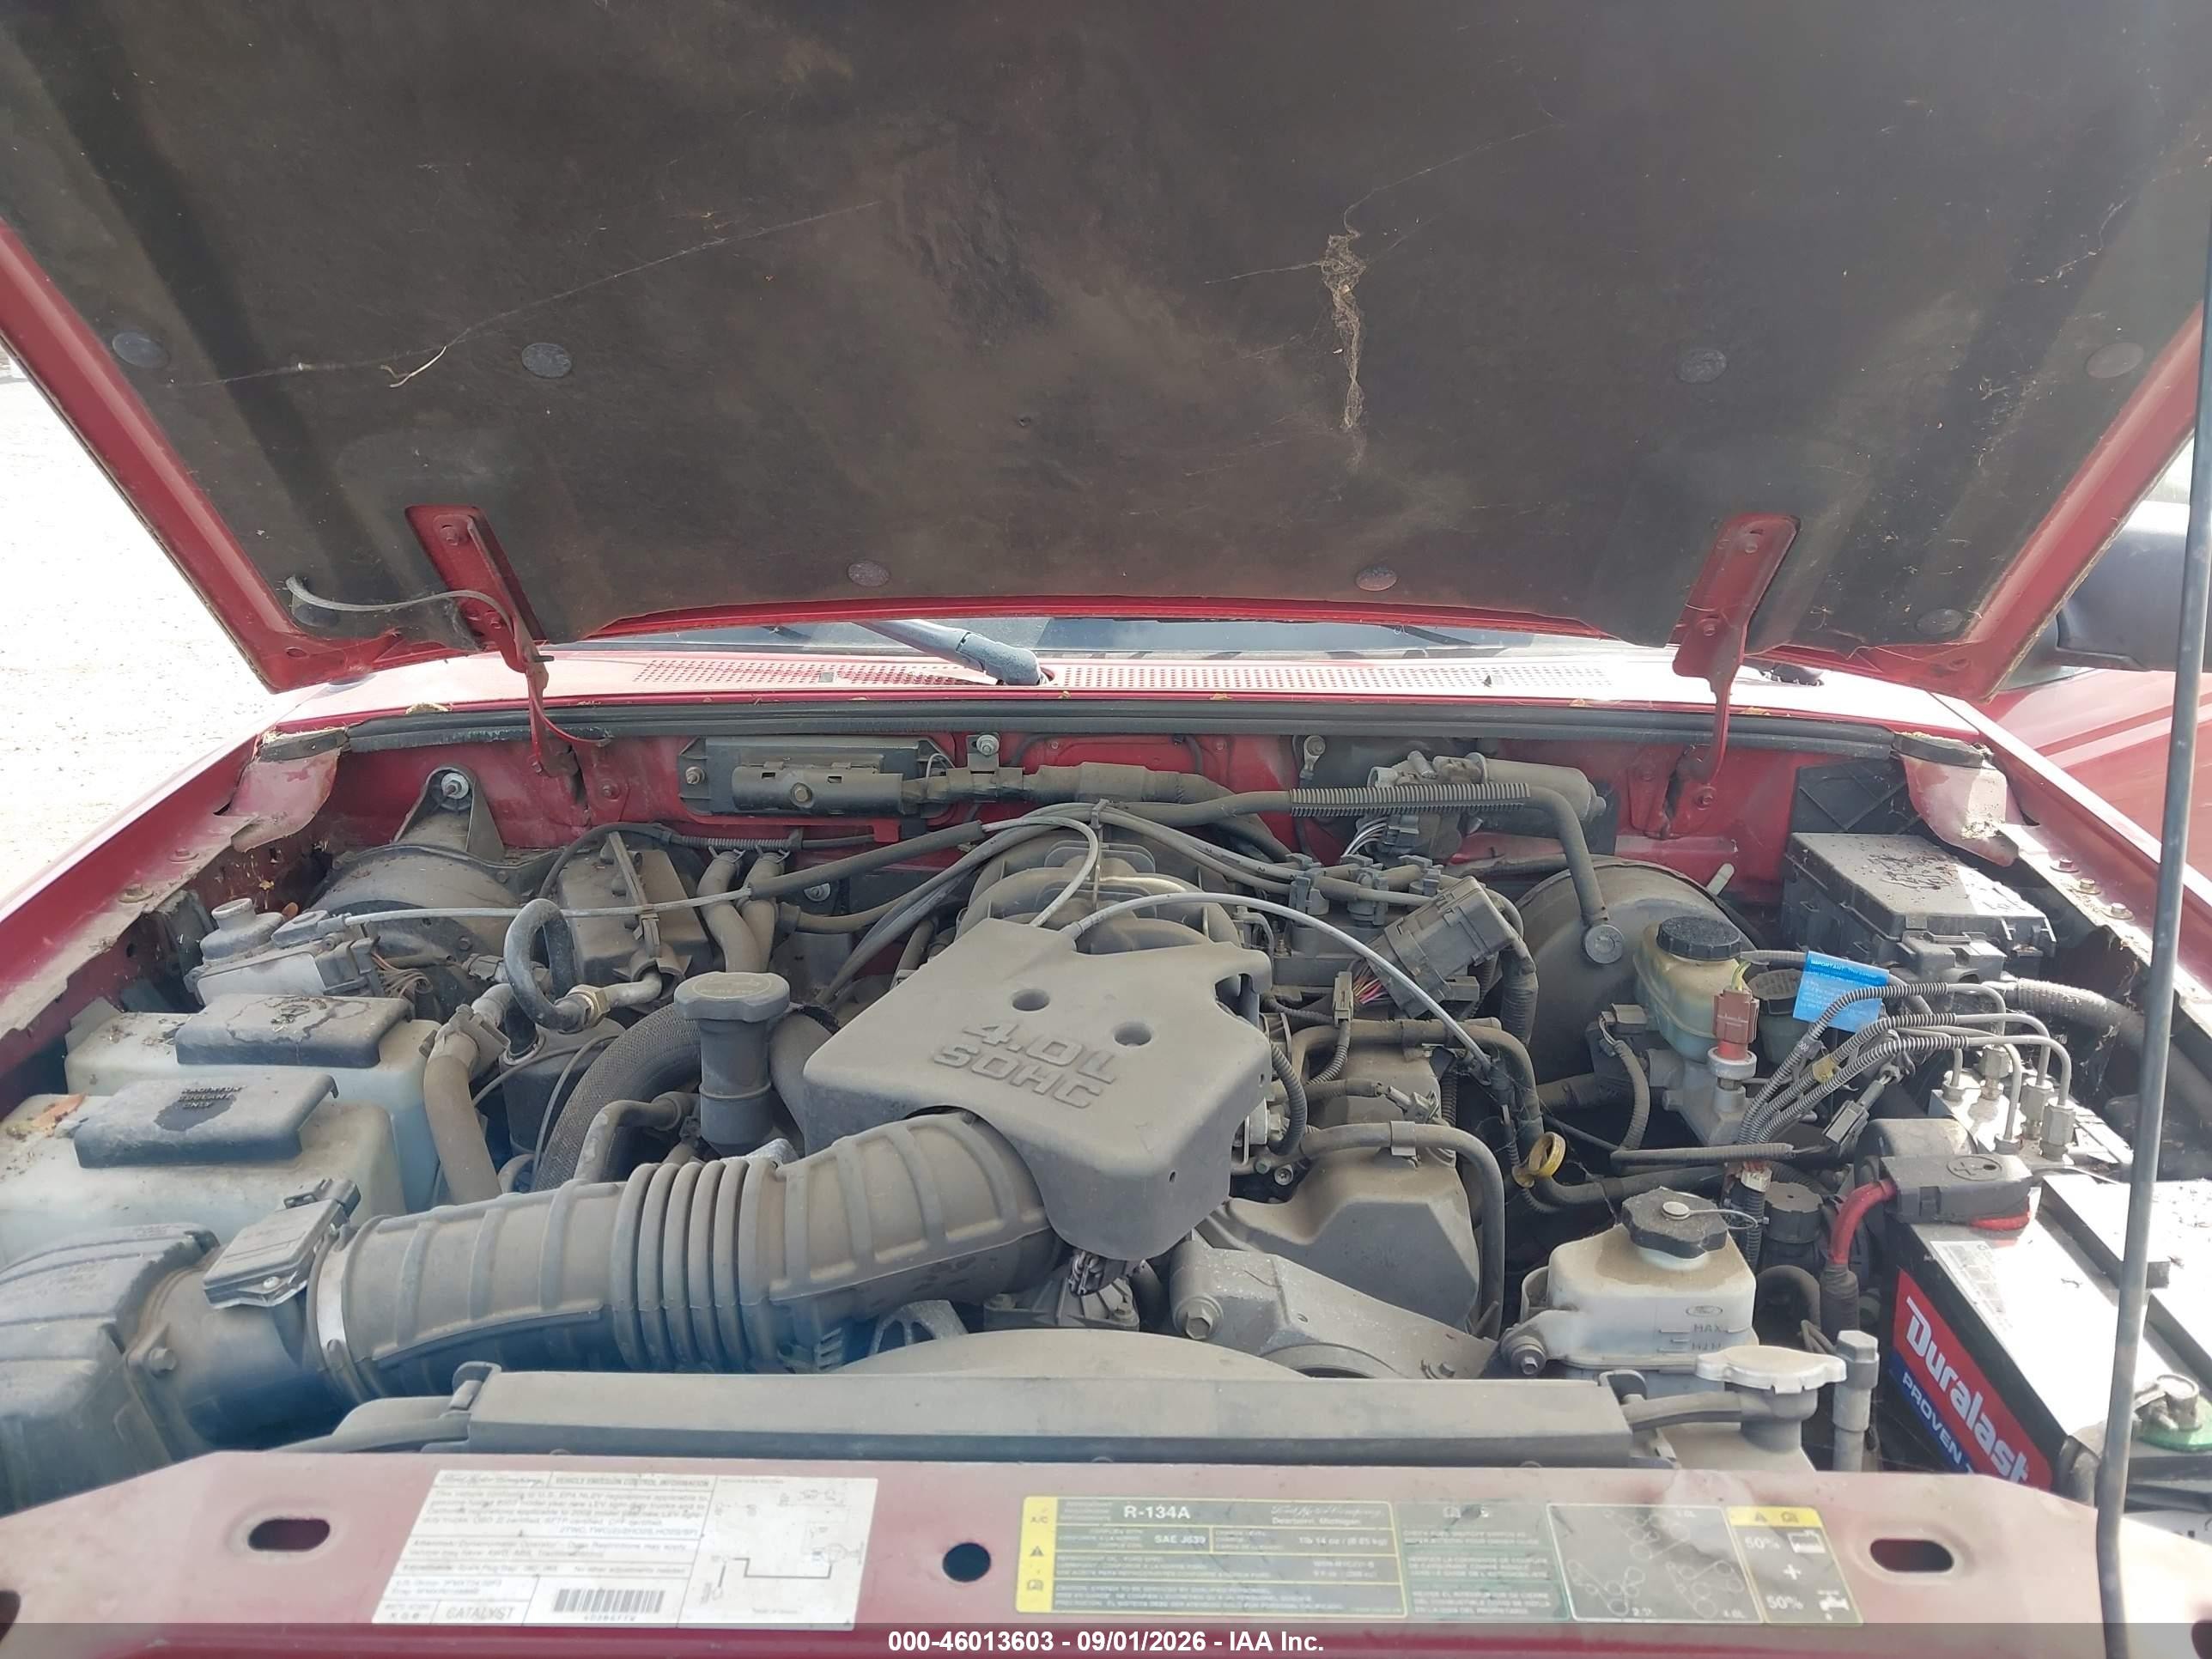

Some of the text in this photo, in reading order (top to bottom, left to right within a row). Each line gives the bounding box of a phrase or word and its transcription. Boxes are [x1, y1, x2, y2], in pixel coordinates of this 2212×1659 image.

[933, 1044, 1104, 1109] SOHC
[962, 1024, 1116, 1085] 4.0L
[1902, 1371, 1963, 1464] PROVEN
[1905, 1296, 2029, 1485] Duralast
[1123, 1504, 1191, 1519] R-134A
[1153, 1534, 1178, 1544] SAE
[447, 1607, 515, 1621] CATALYST
